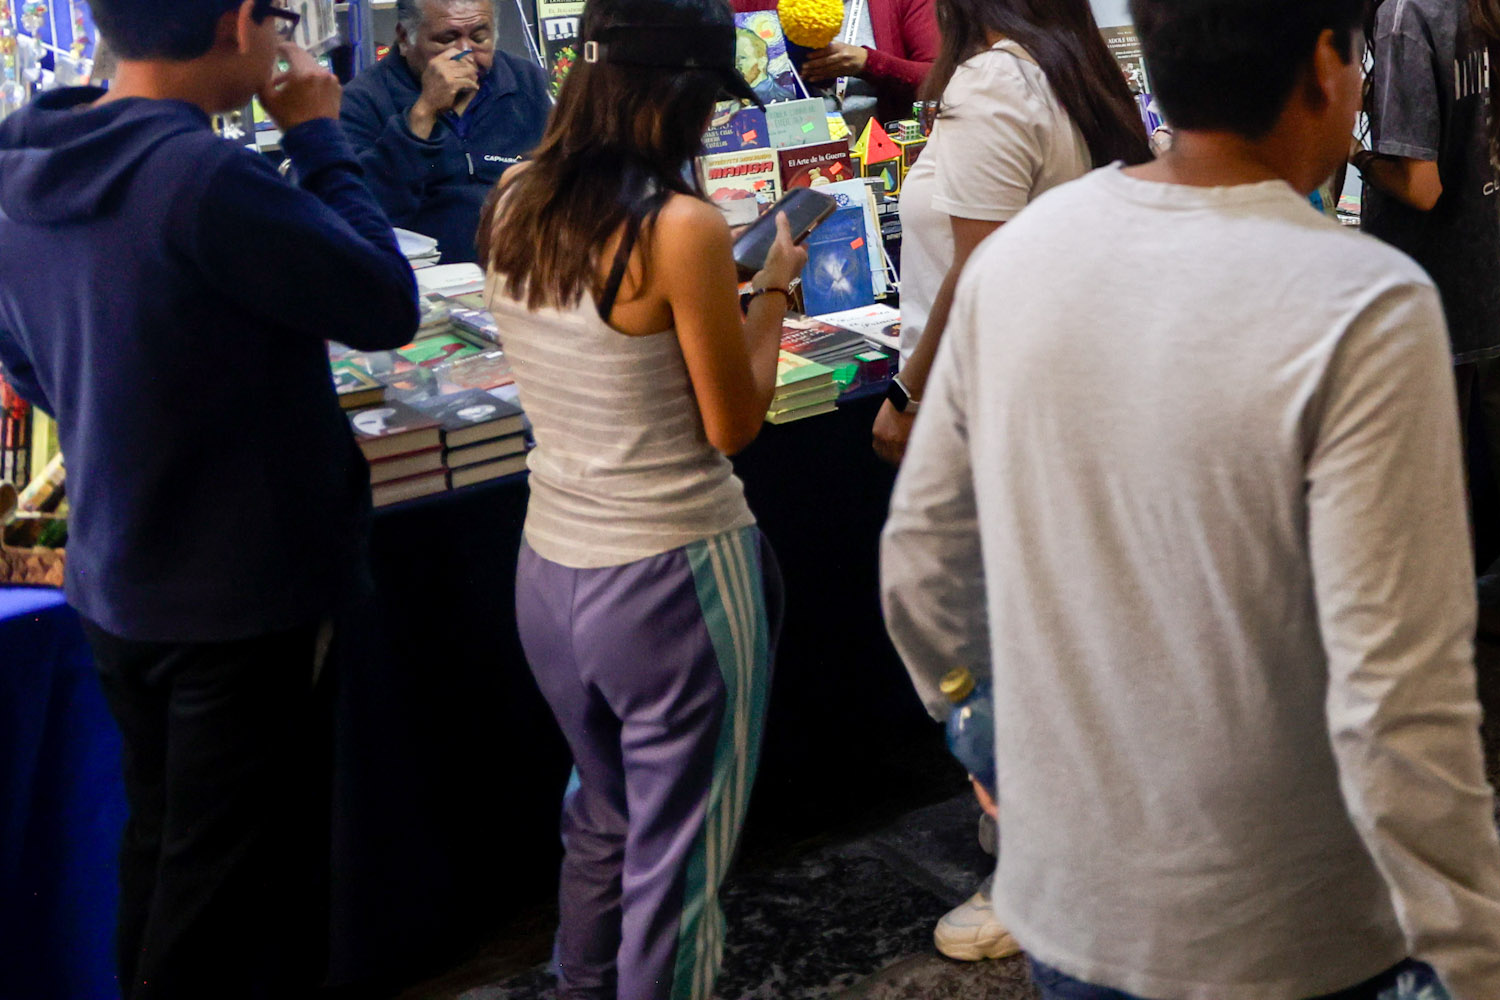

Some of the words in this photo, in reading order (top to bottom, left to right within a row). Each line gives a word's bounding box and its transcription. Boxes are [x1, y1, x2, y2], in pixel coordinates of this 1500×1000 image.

[788, 159, 796, 167] El
[825, 152, 847, 161] Guerra
[708, 160, 774, 179] MANGA
